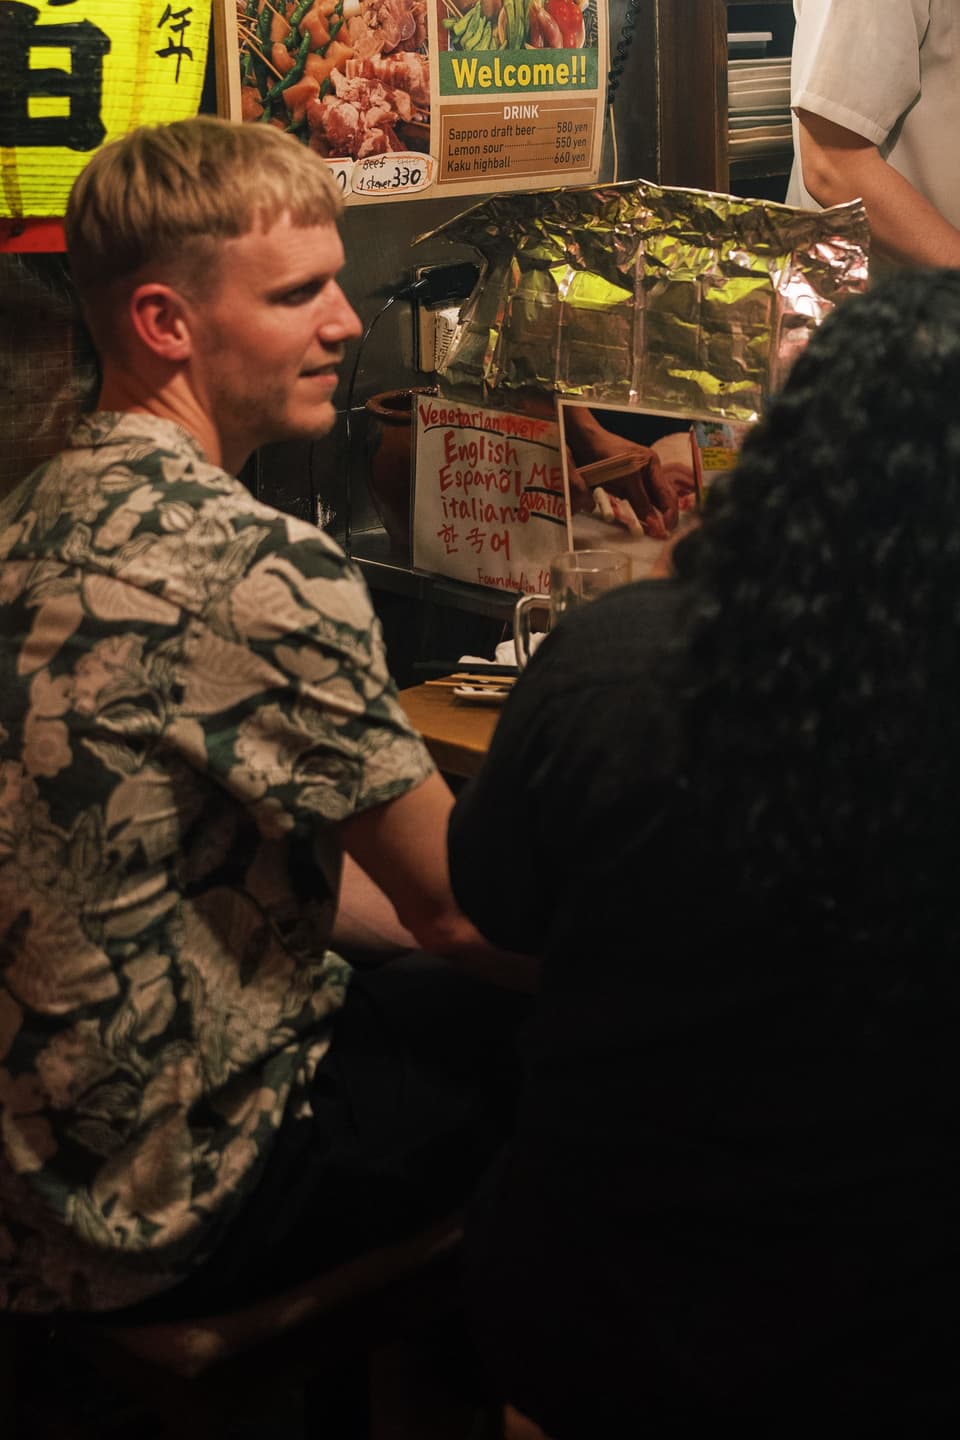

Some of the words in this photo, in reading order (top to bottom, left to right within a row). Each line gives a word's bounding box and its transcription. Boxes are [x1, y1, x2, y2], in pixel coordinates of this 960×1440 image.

[451, 55, 587, 89] Welcome!!
[503, 104, 540, 120] DRINK
[449, 127, 489, 142] Sapporo
[490, 125, 513, 137] draft
[515, 124, 536, 136] beer
[556, 121, 573, 134] 580
[574, 123, 588, 135] yen
[448, 143, 480, 156] Lemon
[482, 142, 505, 154] sour
[555, 136, 572, 149] 550
[572, 138, 587, 150] yen
[362, 156, 386, 171] Beef
[447, 160, 471, 172] Kaku
[473, 156, 511, 173] highball
[554, 152, 570, 165] 660
[571, 153, 586, 165] yen
[391, 167, 422, 188] 330
[418, 402, 500, 433] Vegetarian
[443, 430, 519, 468] English
[527, 462, 563, 490] ME
[519, 491, 566, 518] availa
[437, 524, 511, 561] 한국어
[477, 567, 523, 592] Founded
